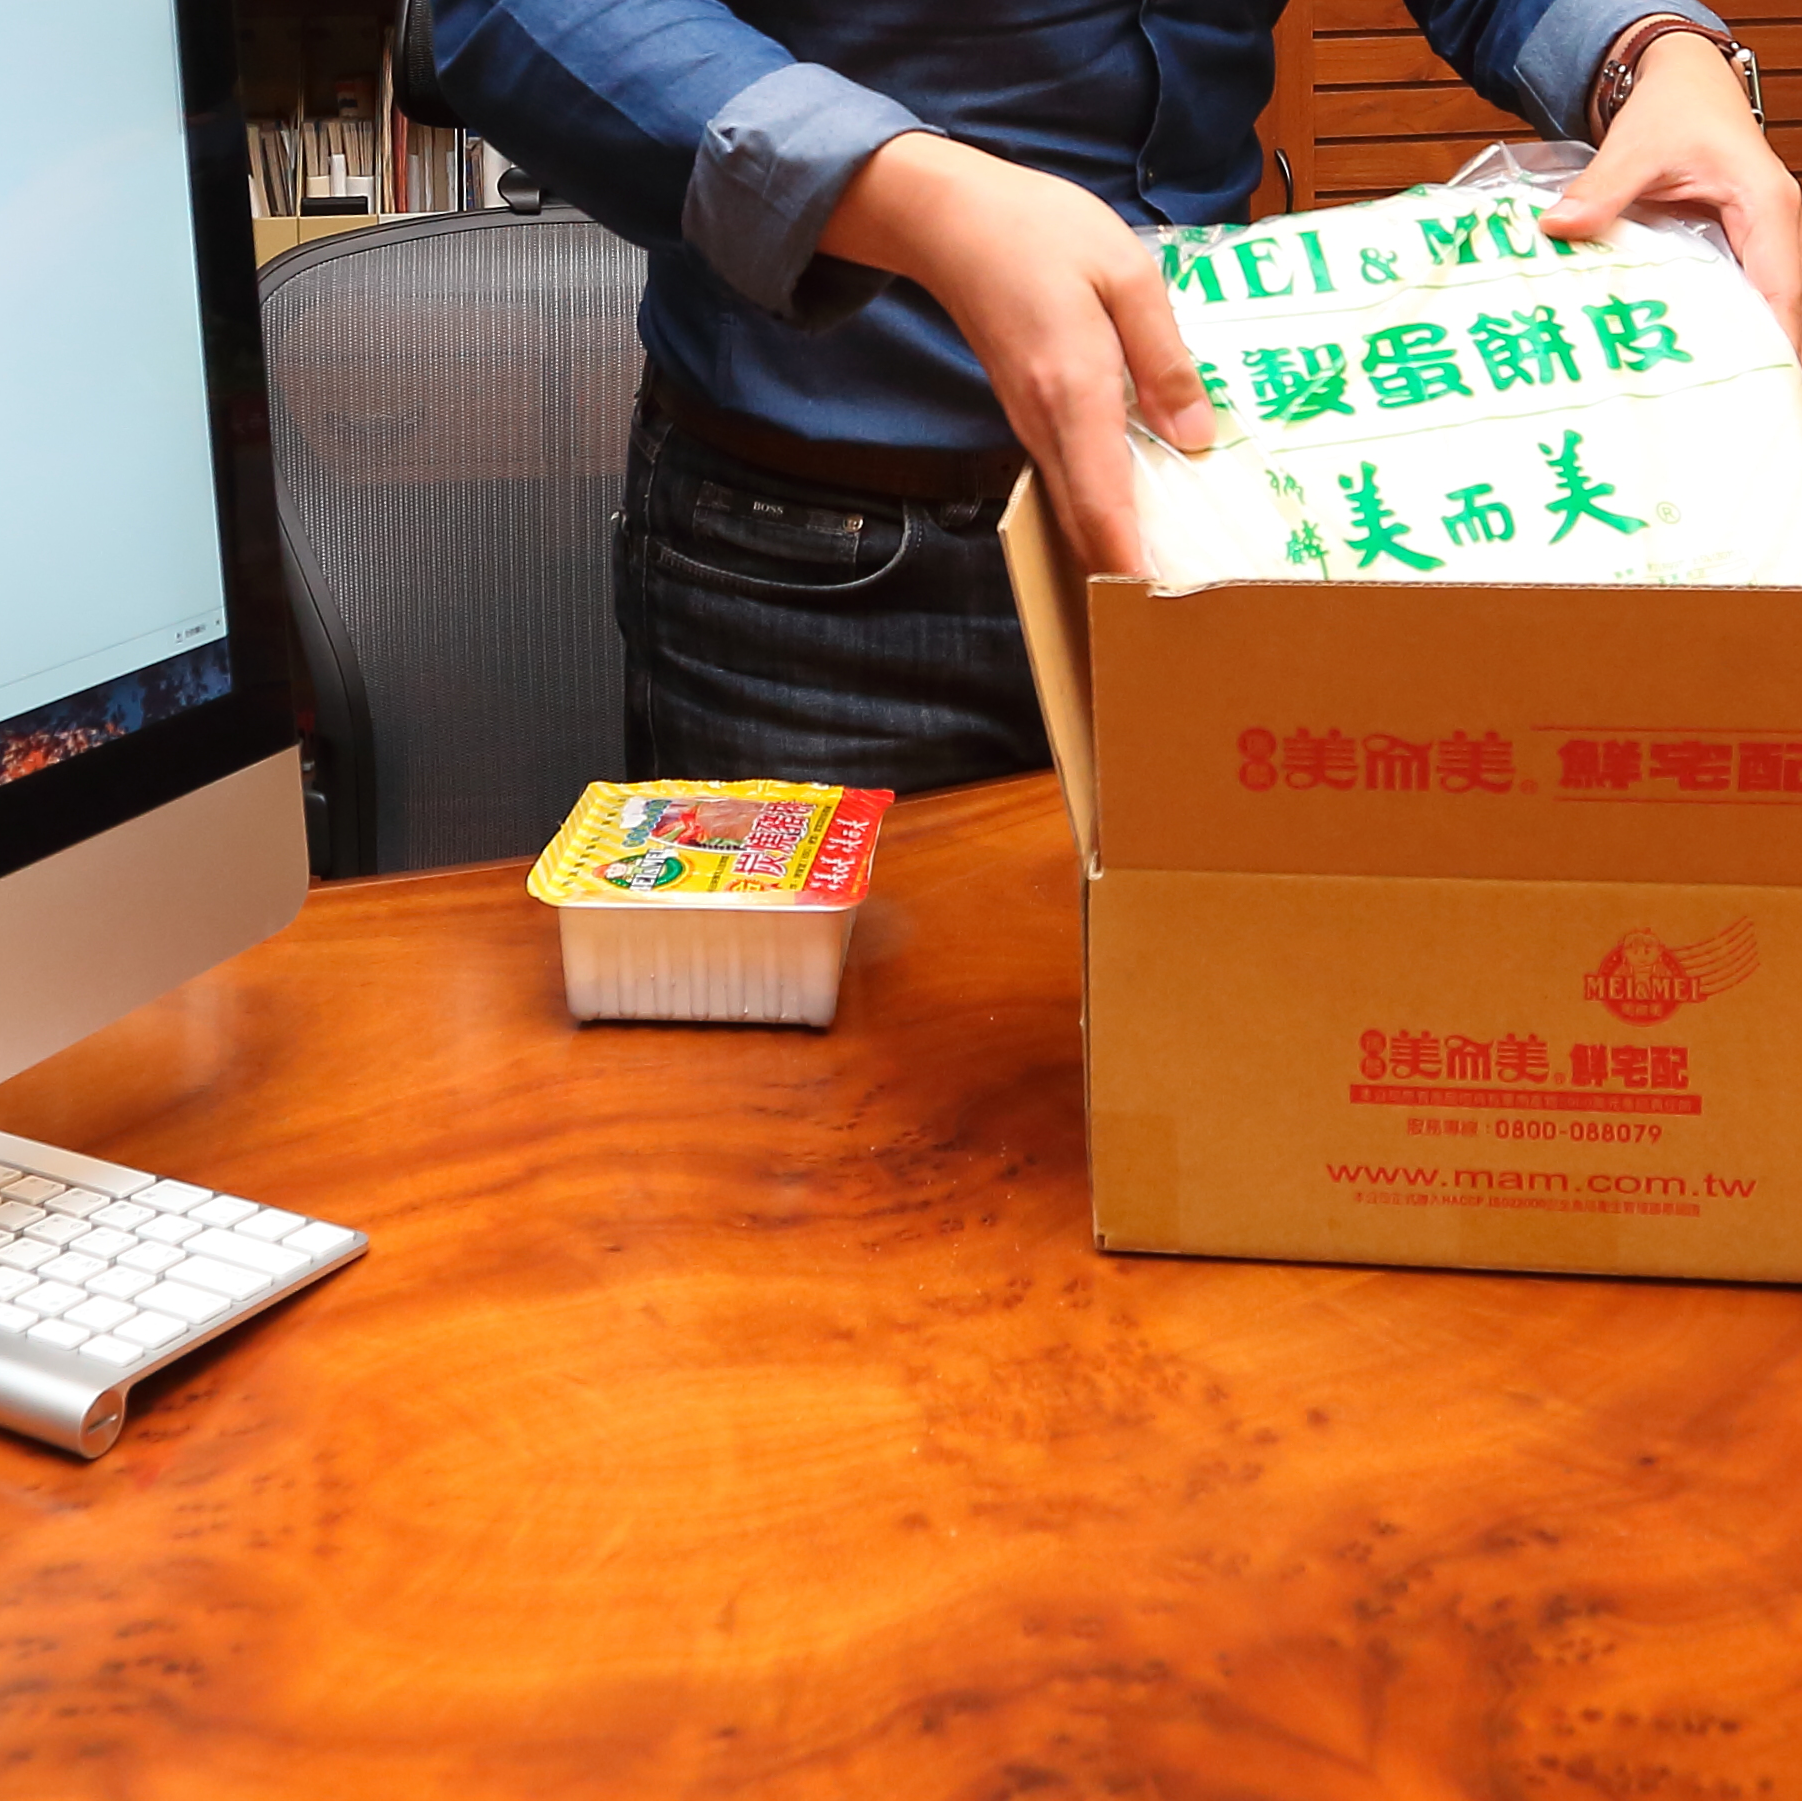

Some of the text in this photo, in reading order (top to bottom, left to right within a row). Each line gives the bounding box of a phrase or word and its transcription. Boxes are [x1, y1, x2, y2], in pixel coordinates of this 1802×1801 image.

[1162, 230, 1335, 307] MEI
[1359, 244, 1399, 285] &
[1339, 429, 1650, 572] 美而美
[1282, 728, 1517, 795] 美而美
[1389, 1030, 1549, 1084] 美而美
[1569, 1044, 1689, 1090] 鮮宅配
[1495, 1119, 1663, 1144] 0800-088079
[1326, 1163, 1759, 1201] www.mam.com.tw
